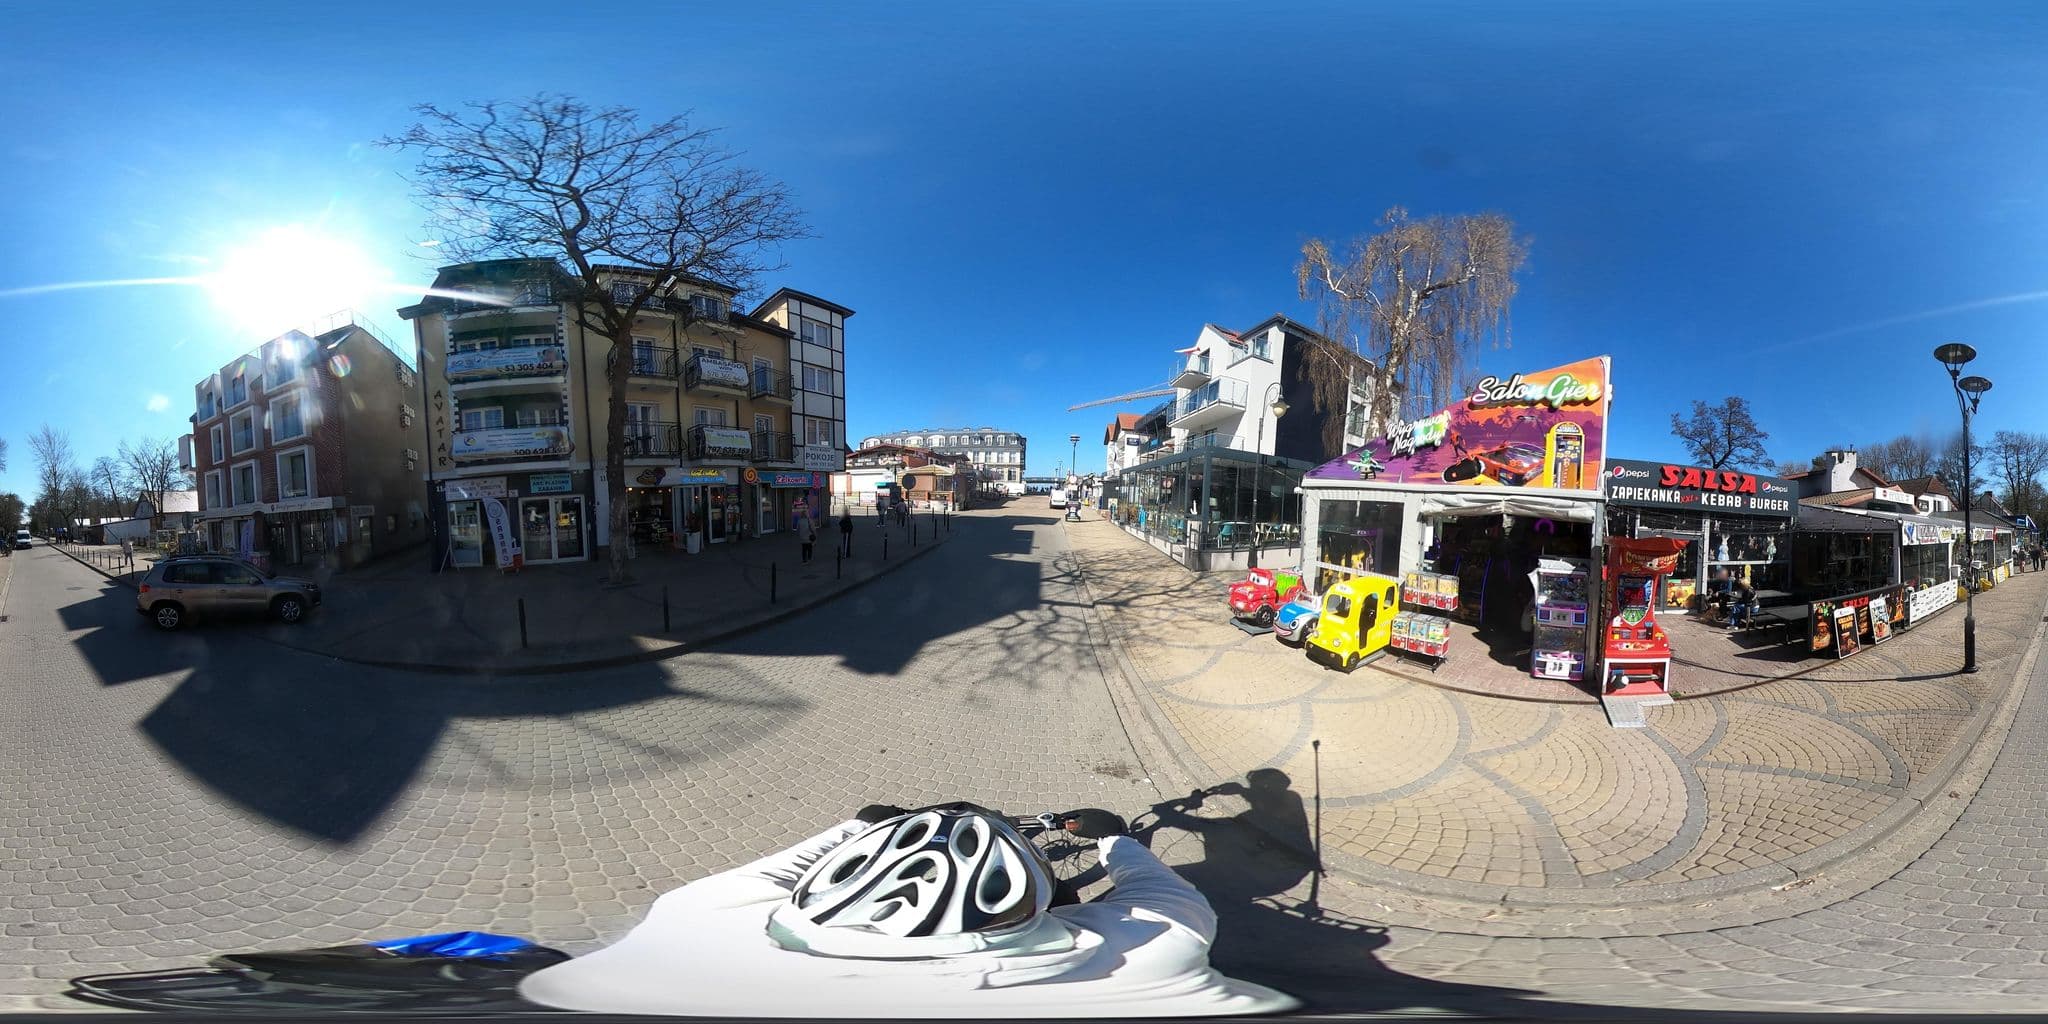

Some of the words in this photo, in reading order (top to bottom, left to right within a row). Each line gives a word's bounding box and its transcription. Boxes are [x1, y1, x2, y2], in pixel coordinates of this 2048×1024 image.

[1471, 373, 1545, 403] Salon
[1546, 372, 1600, 408] Gier
[433, 389, 448, 466] AVATAR
[805, 453, 835, 462] POKOJE
[1625, 470, 1649, 478] pepsi
[1659, 465, 1757, 494] SALSA
[1611, 486, 1681, 503] ZAPIEKANKA
[1701, 493, 1742, 508] KEBAB
[1750, 497, 1789, 511] BURGER
[1771, 485, 1788, 493] pepsi
